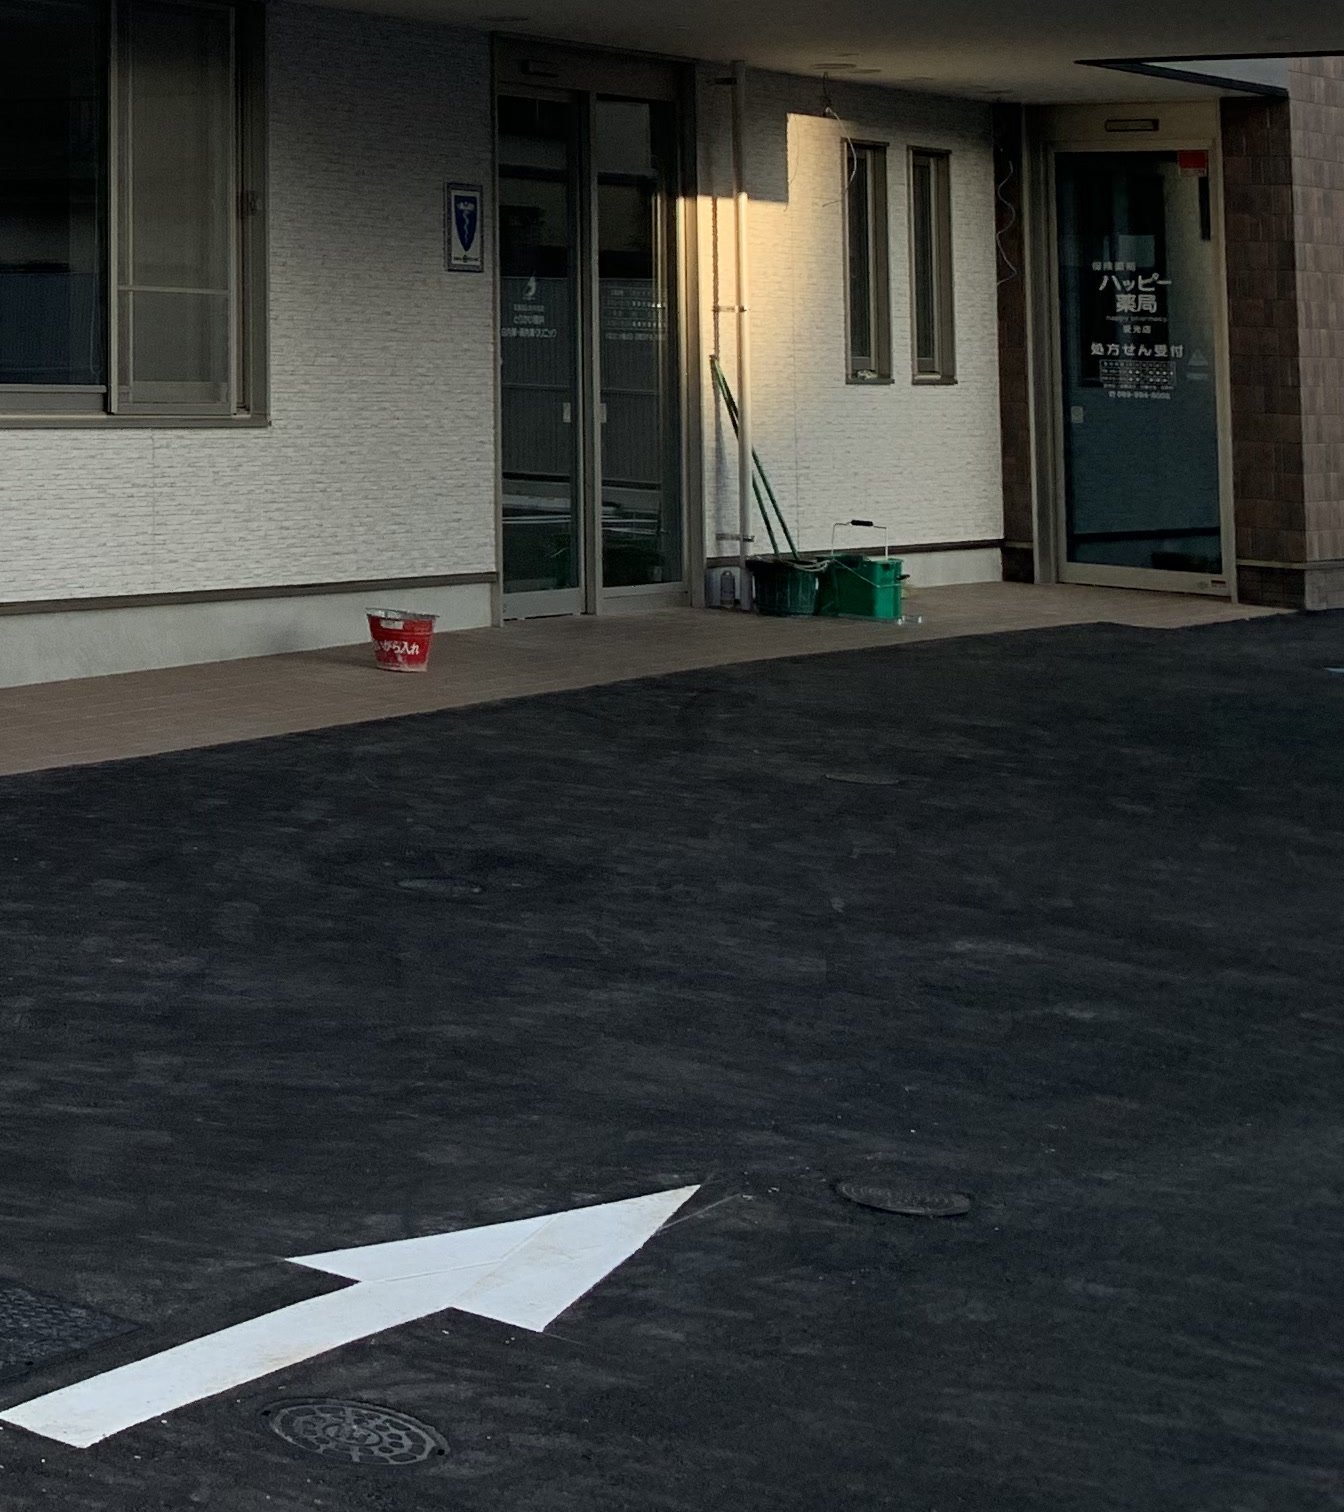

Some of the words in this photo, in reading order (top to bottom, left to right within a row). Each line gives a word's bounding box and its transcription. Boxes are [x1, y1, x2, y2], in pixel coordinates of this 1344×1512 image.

[1098, 272, 1172, 292] ハッピー
[1115, 294, 1158, 313] 薬局
[1091, 343, 1184, 358] 処方せん受付
